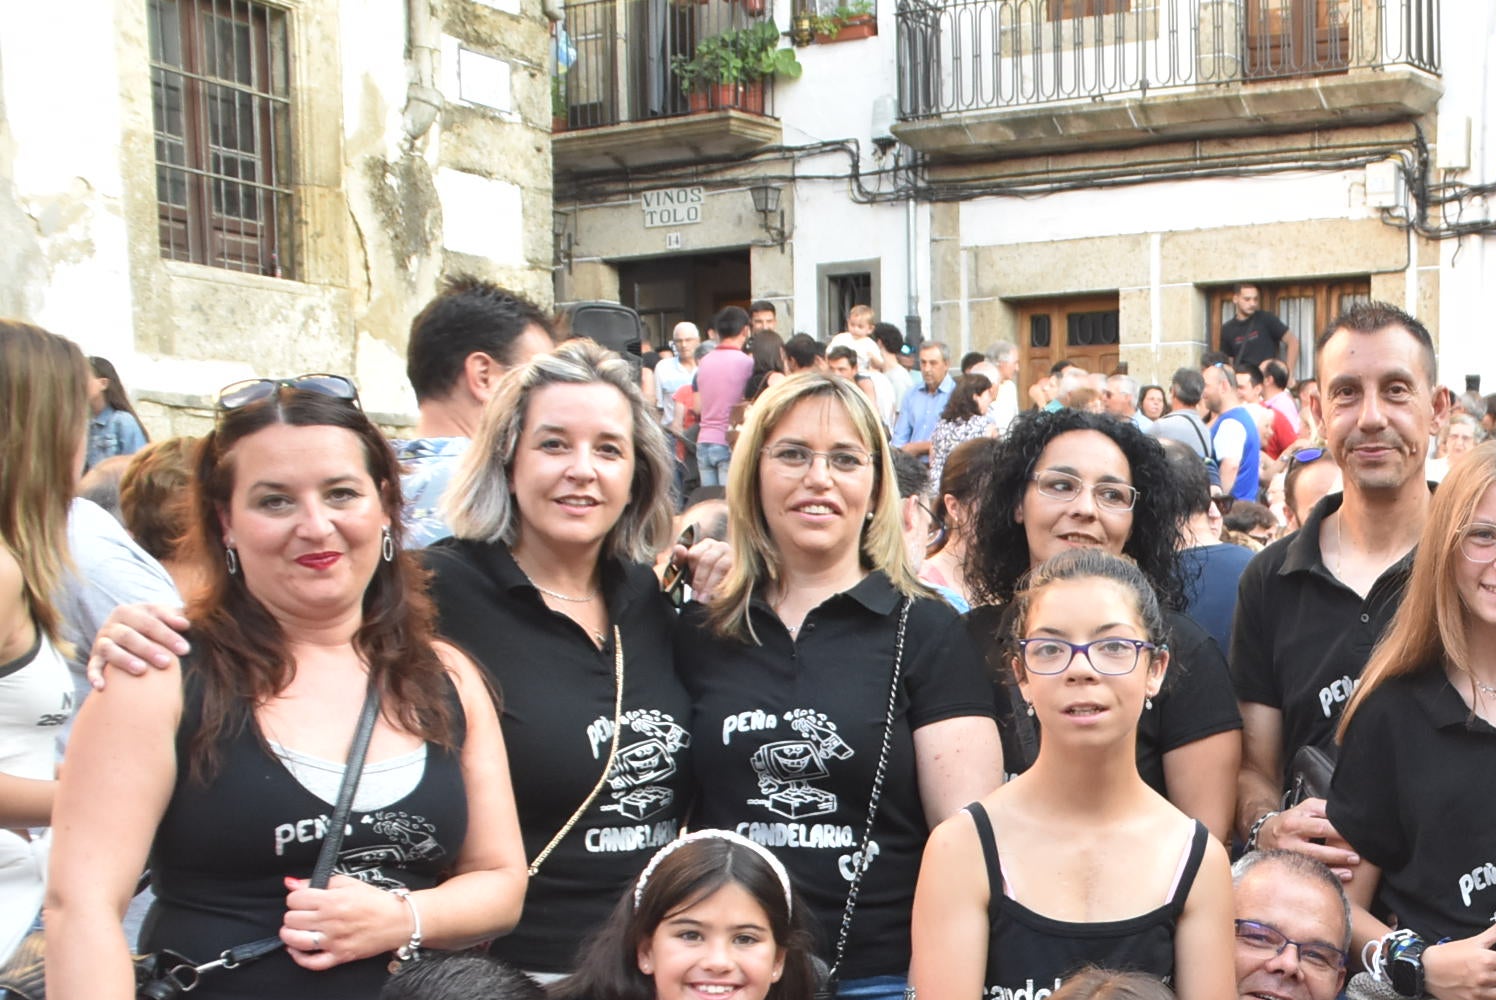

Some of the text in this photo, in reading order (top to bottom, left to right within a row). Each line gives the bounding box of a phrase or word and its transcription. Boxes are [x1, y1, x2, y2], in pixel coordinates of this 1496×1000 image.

[643, 187, 702, 207] VINOS
[646, 207, 698, 225] TOLO
[723, 709, 778, 745] PEÑA
